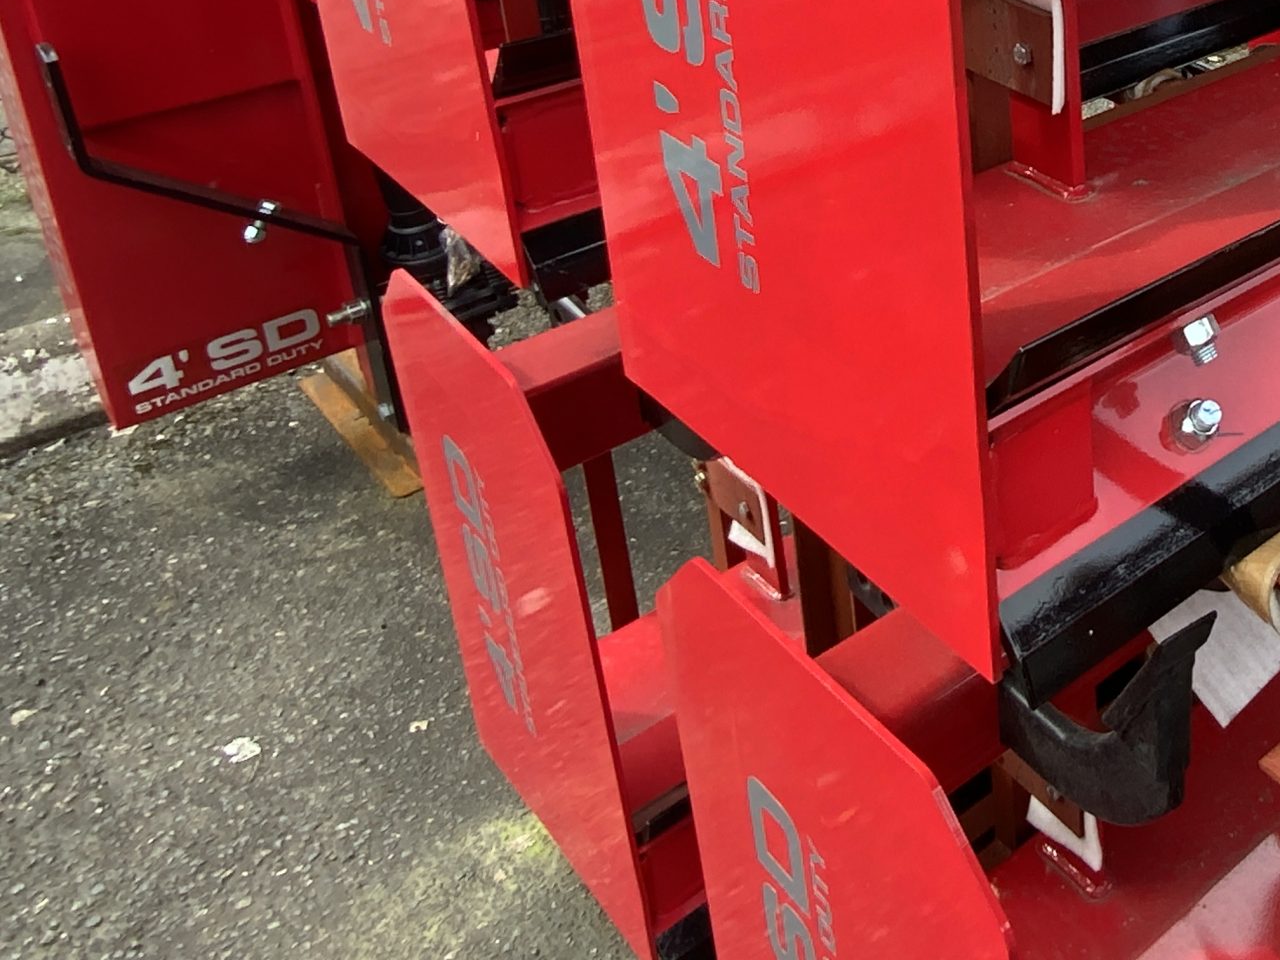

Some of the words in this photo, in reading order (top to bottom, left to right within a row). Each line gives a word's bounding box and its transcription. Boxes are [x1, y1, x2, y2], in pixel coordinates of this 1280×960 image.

[653, 81, 724, 269] 4'
[128, 349, 190, 397] 4'
[206, 308, 322, 371] SD
[134, 363, 262, 416] STANDARD
[266, 338, 324, 367] DUTY
[442, 433, 502, 615] SD
[747, 775, 818, 960] SD
